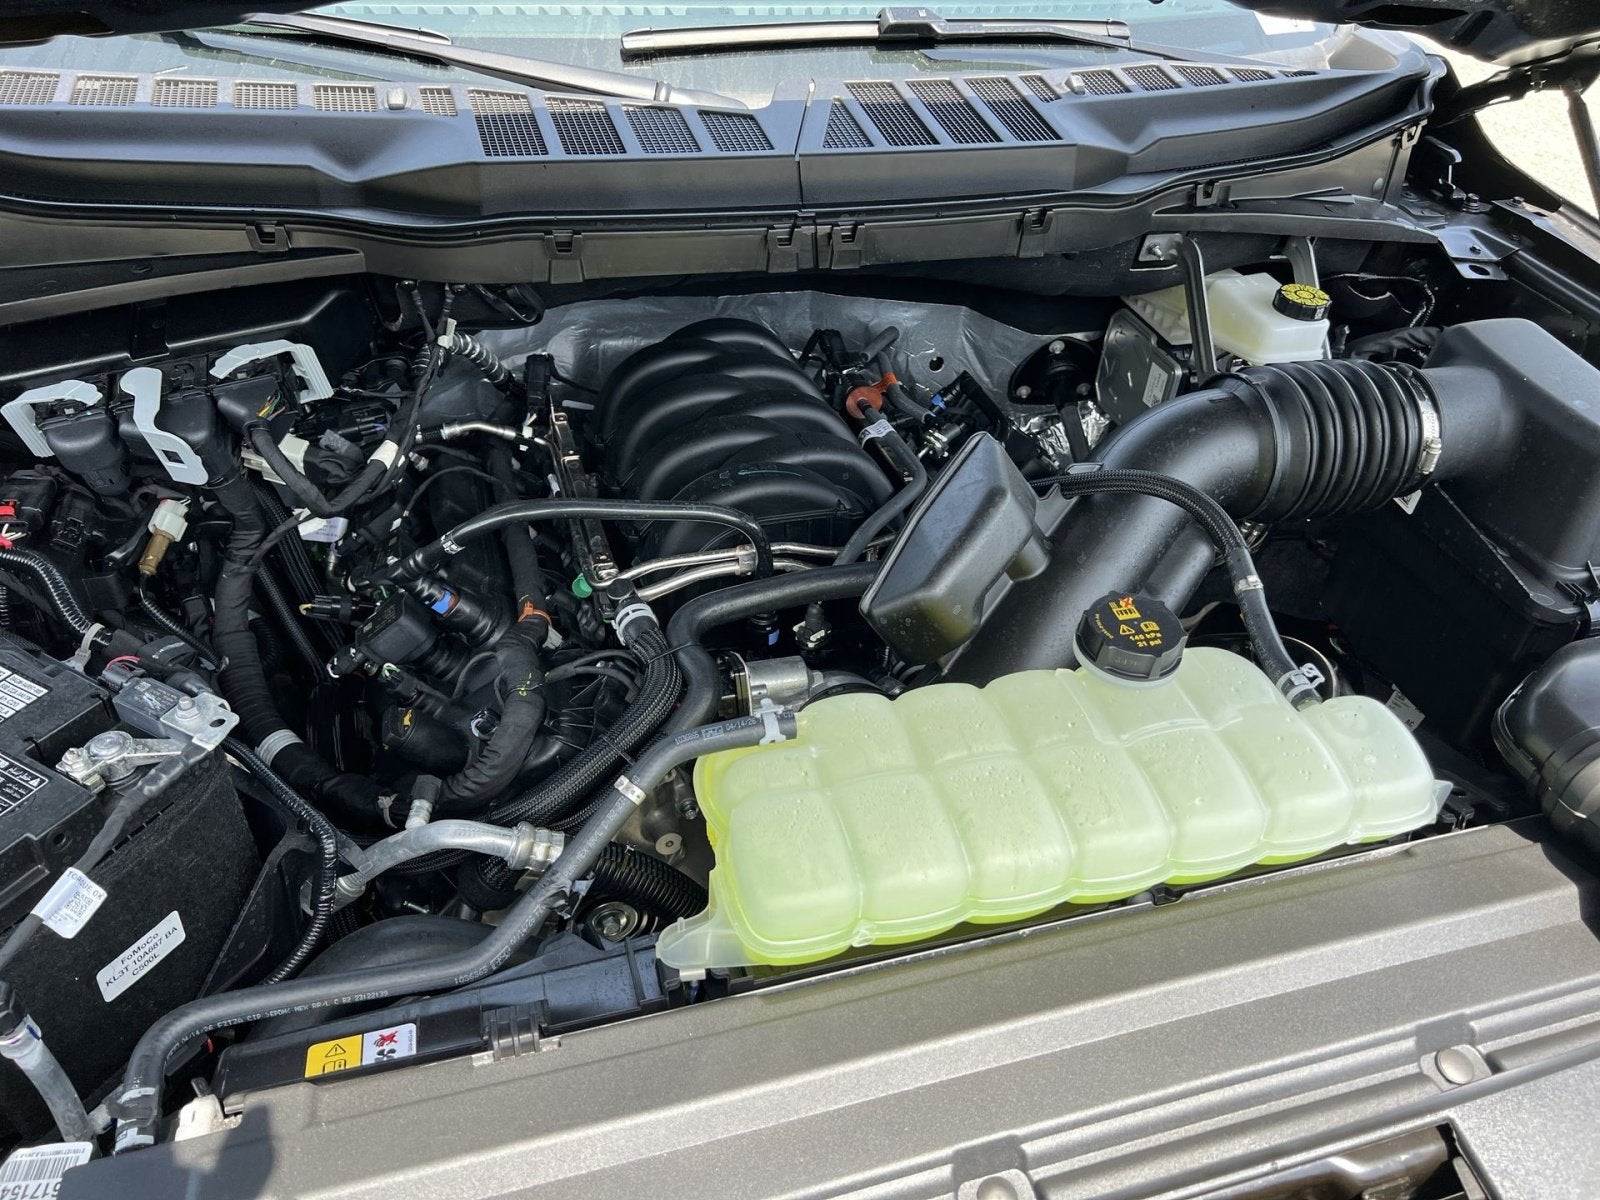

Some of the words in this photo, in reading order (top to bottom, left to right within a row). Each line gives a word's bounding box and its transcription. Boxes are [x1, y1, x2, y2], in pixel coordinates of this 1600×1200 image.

[67, 871, 93, 893] TORQUE
[92, 889, 104, 900] OK
[105, 964, 130, 987] KL3T
[132, 938, 163, 966] 10A687
[121, 933, 159, 965] FoMoCo
